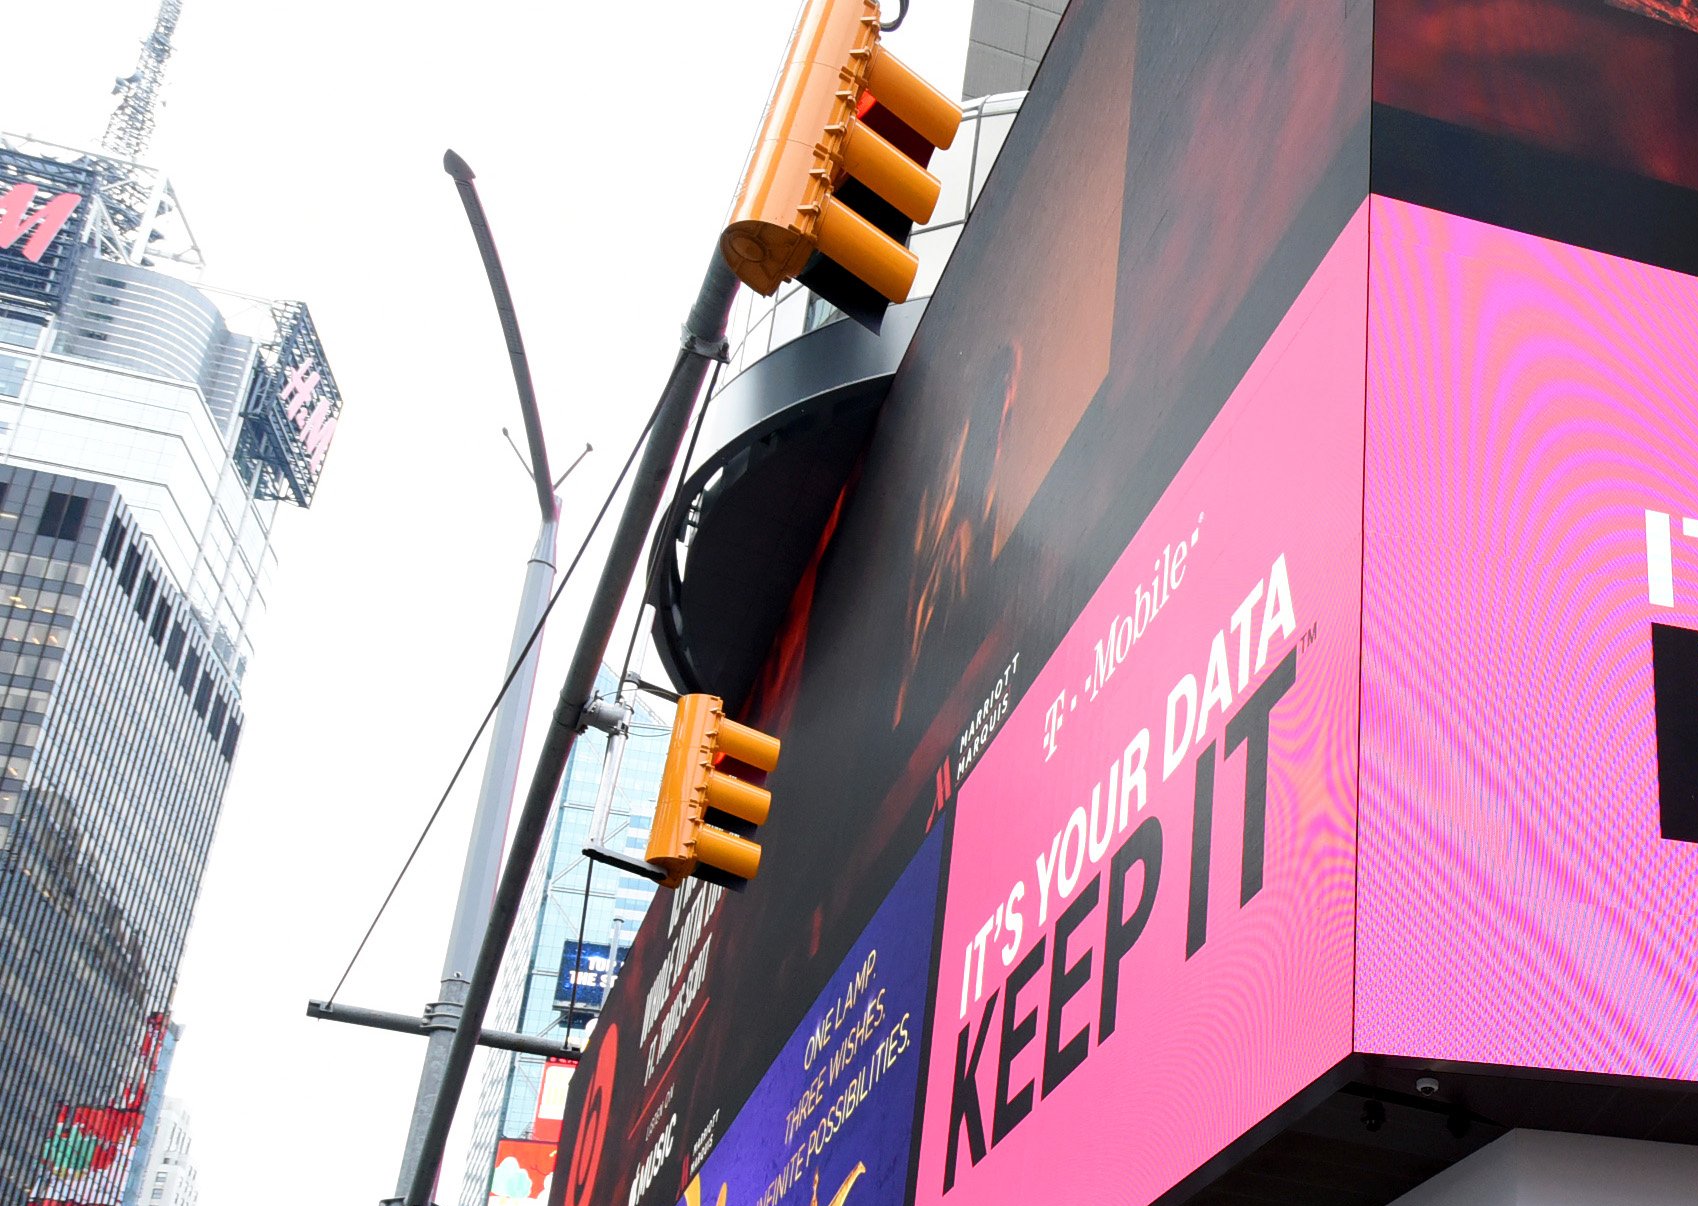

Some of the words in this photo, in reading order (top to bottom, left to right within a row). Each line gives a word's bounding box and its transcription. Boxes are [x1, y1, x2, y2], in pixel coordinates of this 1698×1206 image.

[956, 692, 1010, 781] MARQUIS
[959, 652, 1020, 753] MARRIOTT
[959, 880, 1025, 1020] IT'S
[1036, 727, 1150, 927] YOUR
[1162, 553, 1297, 784] DATA
[784, 1065, 827, 1145] THREE
[829, 988, 886, 1087] WISHES.
[803, 1006, 834, 1071] ONE
[834, 949, 877, 1030] LAMP.
[941, 815, 1163, 1197] KEEP
[636, 1112, 677, 1205] MUSIC
[805, 1012, 911, 1168] POSSIBILITIES.
